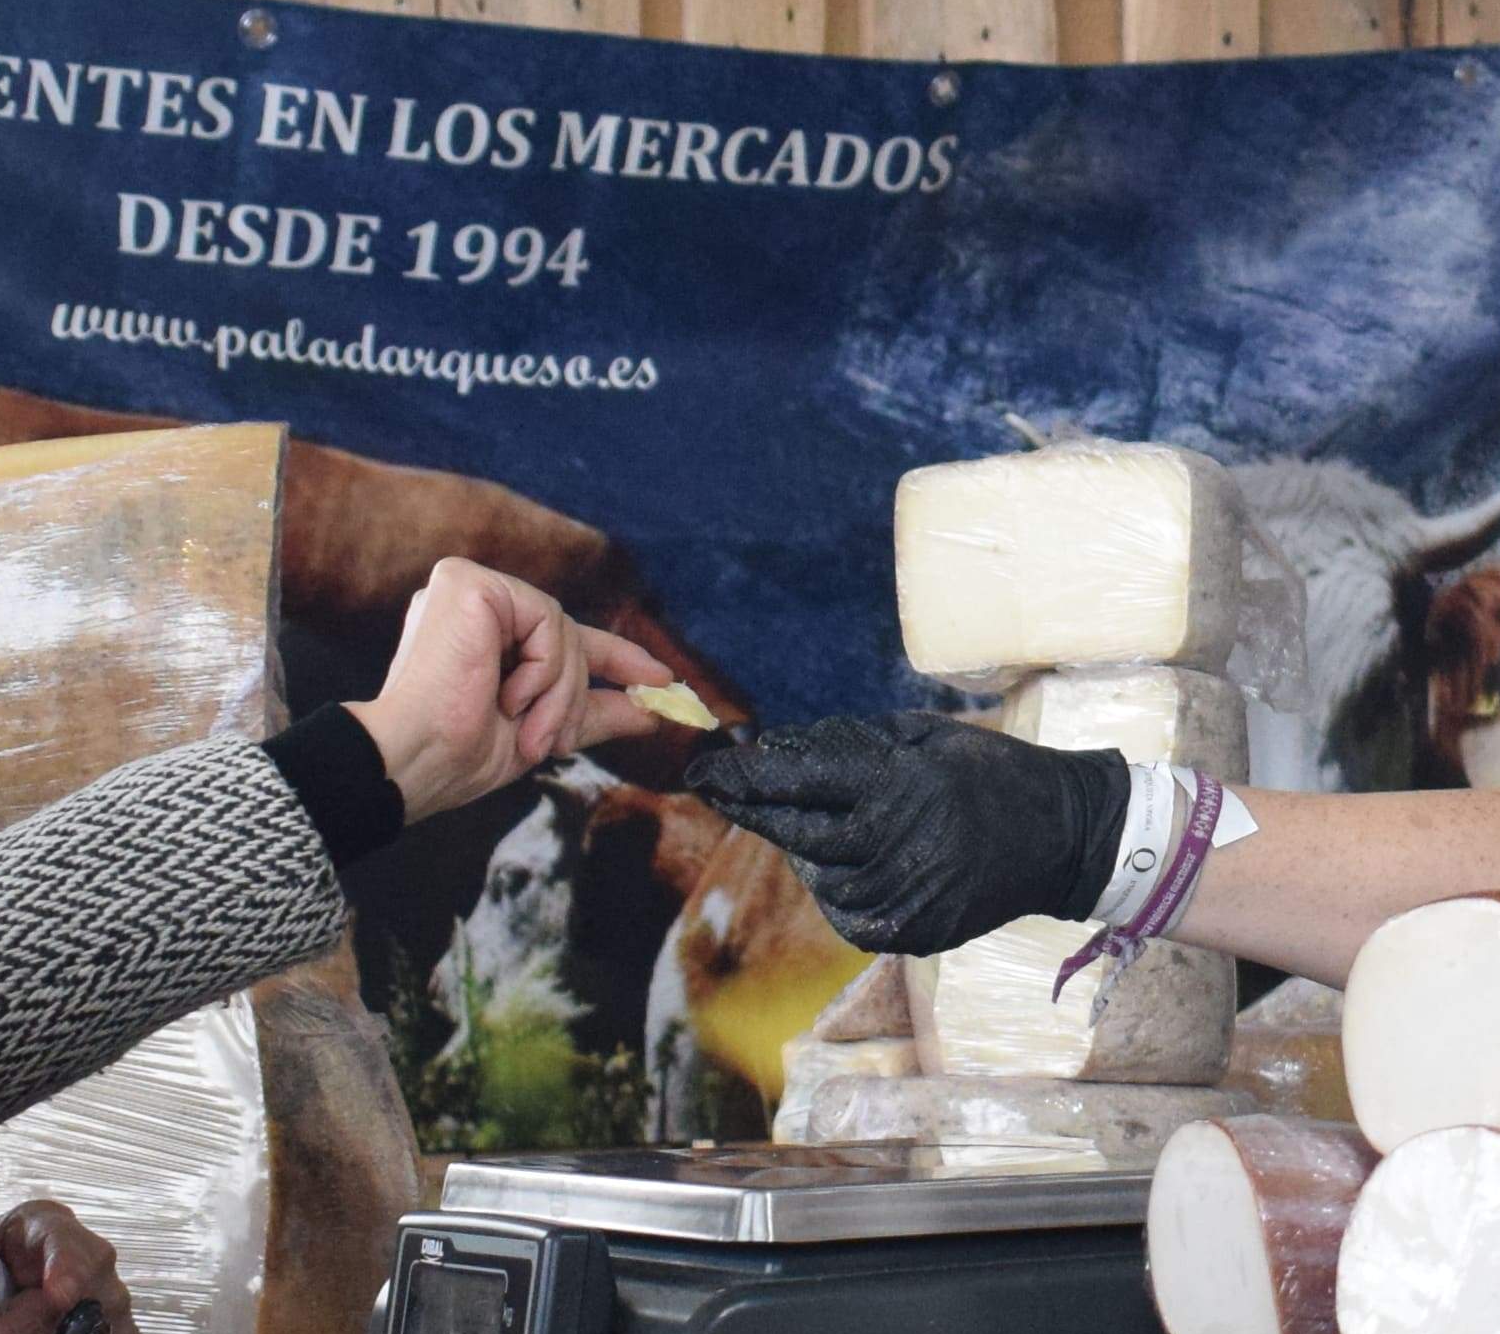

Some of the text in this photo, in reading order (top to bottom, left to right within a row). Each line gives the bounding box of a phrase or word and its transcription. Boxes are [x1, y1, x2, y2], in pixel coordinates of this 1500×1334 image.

[255, 82, 369, 156] EN
[386, 97, 538, 168] LOS
[551, 111, 961, 195] MERCADOS
[116, 192, 591, 288] DESDE 1994
[50, 301, 659, 396] www.paladarqueso.es
